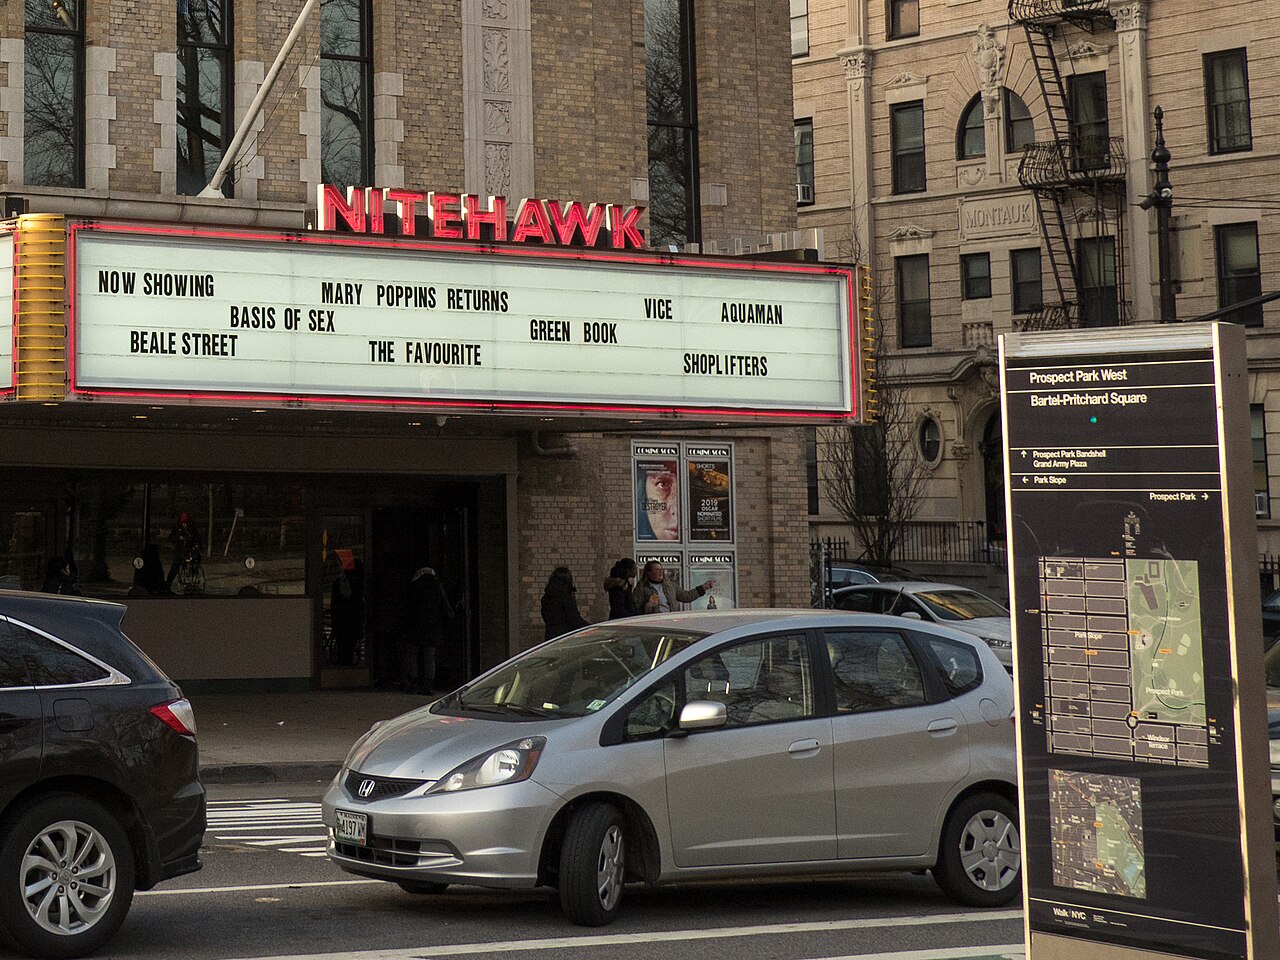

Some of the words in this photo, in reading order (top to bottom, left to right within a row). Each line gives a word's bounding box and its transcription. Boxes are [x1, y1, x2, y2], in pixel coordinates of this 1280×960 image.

[318, 184, 647, 249] NITEHAWK
[966, 204, 1030, 228] MONTAUK
[99, 270, 135, 295] NOW
[143, 272, 215, 298] SHOWING
[321, 281, 363, 305] MARY
[376, 284, 437, 309] POPPINS
[447, 288, 509, 313] RETURNS
[644, 297, 673, 321] VICE
[230, 306, 277, 330] BASIS
[284, 308, 302, 331] OF
[308, 310, 336, 333] SEX
[721, 302, 783, 326] AQUAMAN
[130, 330, 177, 355] BEALE
[182, 333, 239, 357] STREET
[529, 319, 571, 343] GREEN
[583, 321, 618, 344] BOOK
[369, 340, 395, 363] THE
[406, 342, 482, 366] FAVOURITE
[683, 352, 768, 377] SHOPLIFTERS
[1030, 370, 1074, 385] Prospect
[1076, 370, 1099, 382] Park
[1101, 368, 1128, 381] West
[1031, 394, 1109, 407] Bartel-Pritchard
[1110, 393, 1147, 407] Square
[1033, 450, 1060, 460] Prospect
[1061, 450, 1076, 458] Park
[1076, 449, 1106, 458] Bandshell
[1033, 460, 1052, 468] Grand
[1052, 459, 1070, 469] Army
[1071, 459, 1087, 468] Plaza
[1034, 476, 1048, 484] Park
[1049, 476, 1067, 485] Slope
[1149, 493, 1179, 502] Prospect
[1180, 493, 1196, 501] Park
[1146, 687, 1171, 697] Prospect
[1052, 908, 1069, 918] Walk
[1071, 911, 1086, 920] NYC
